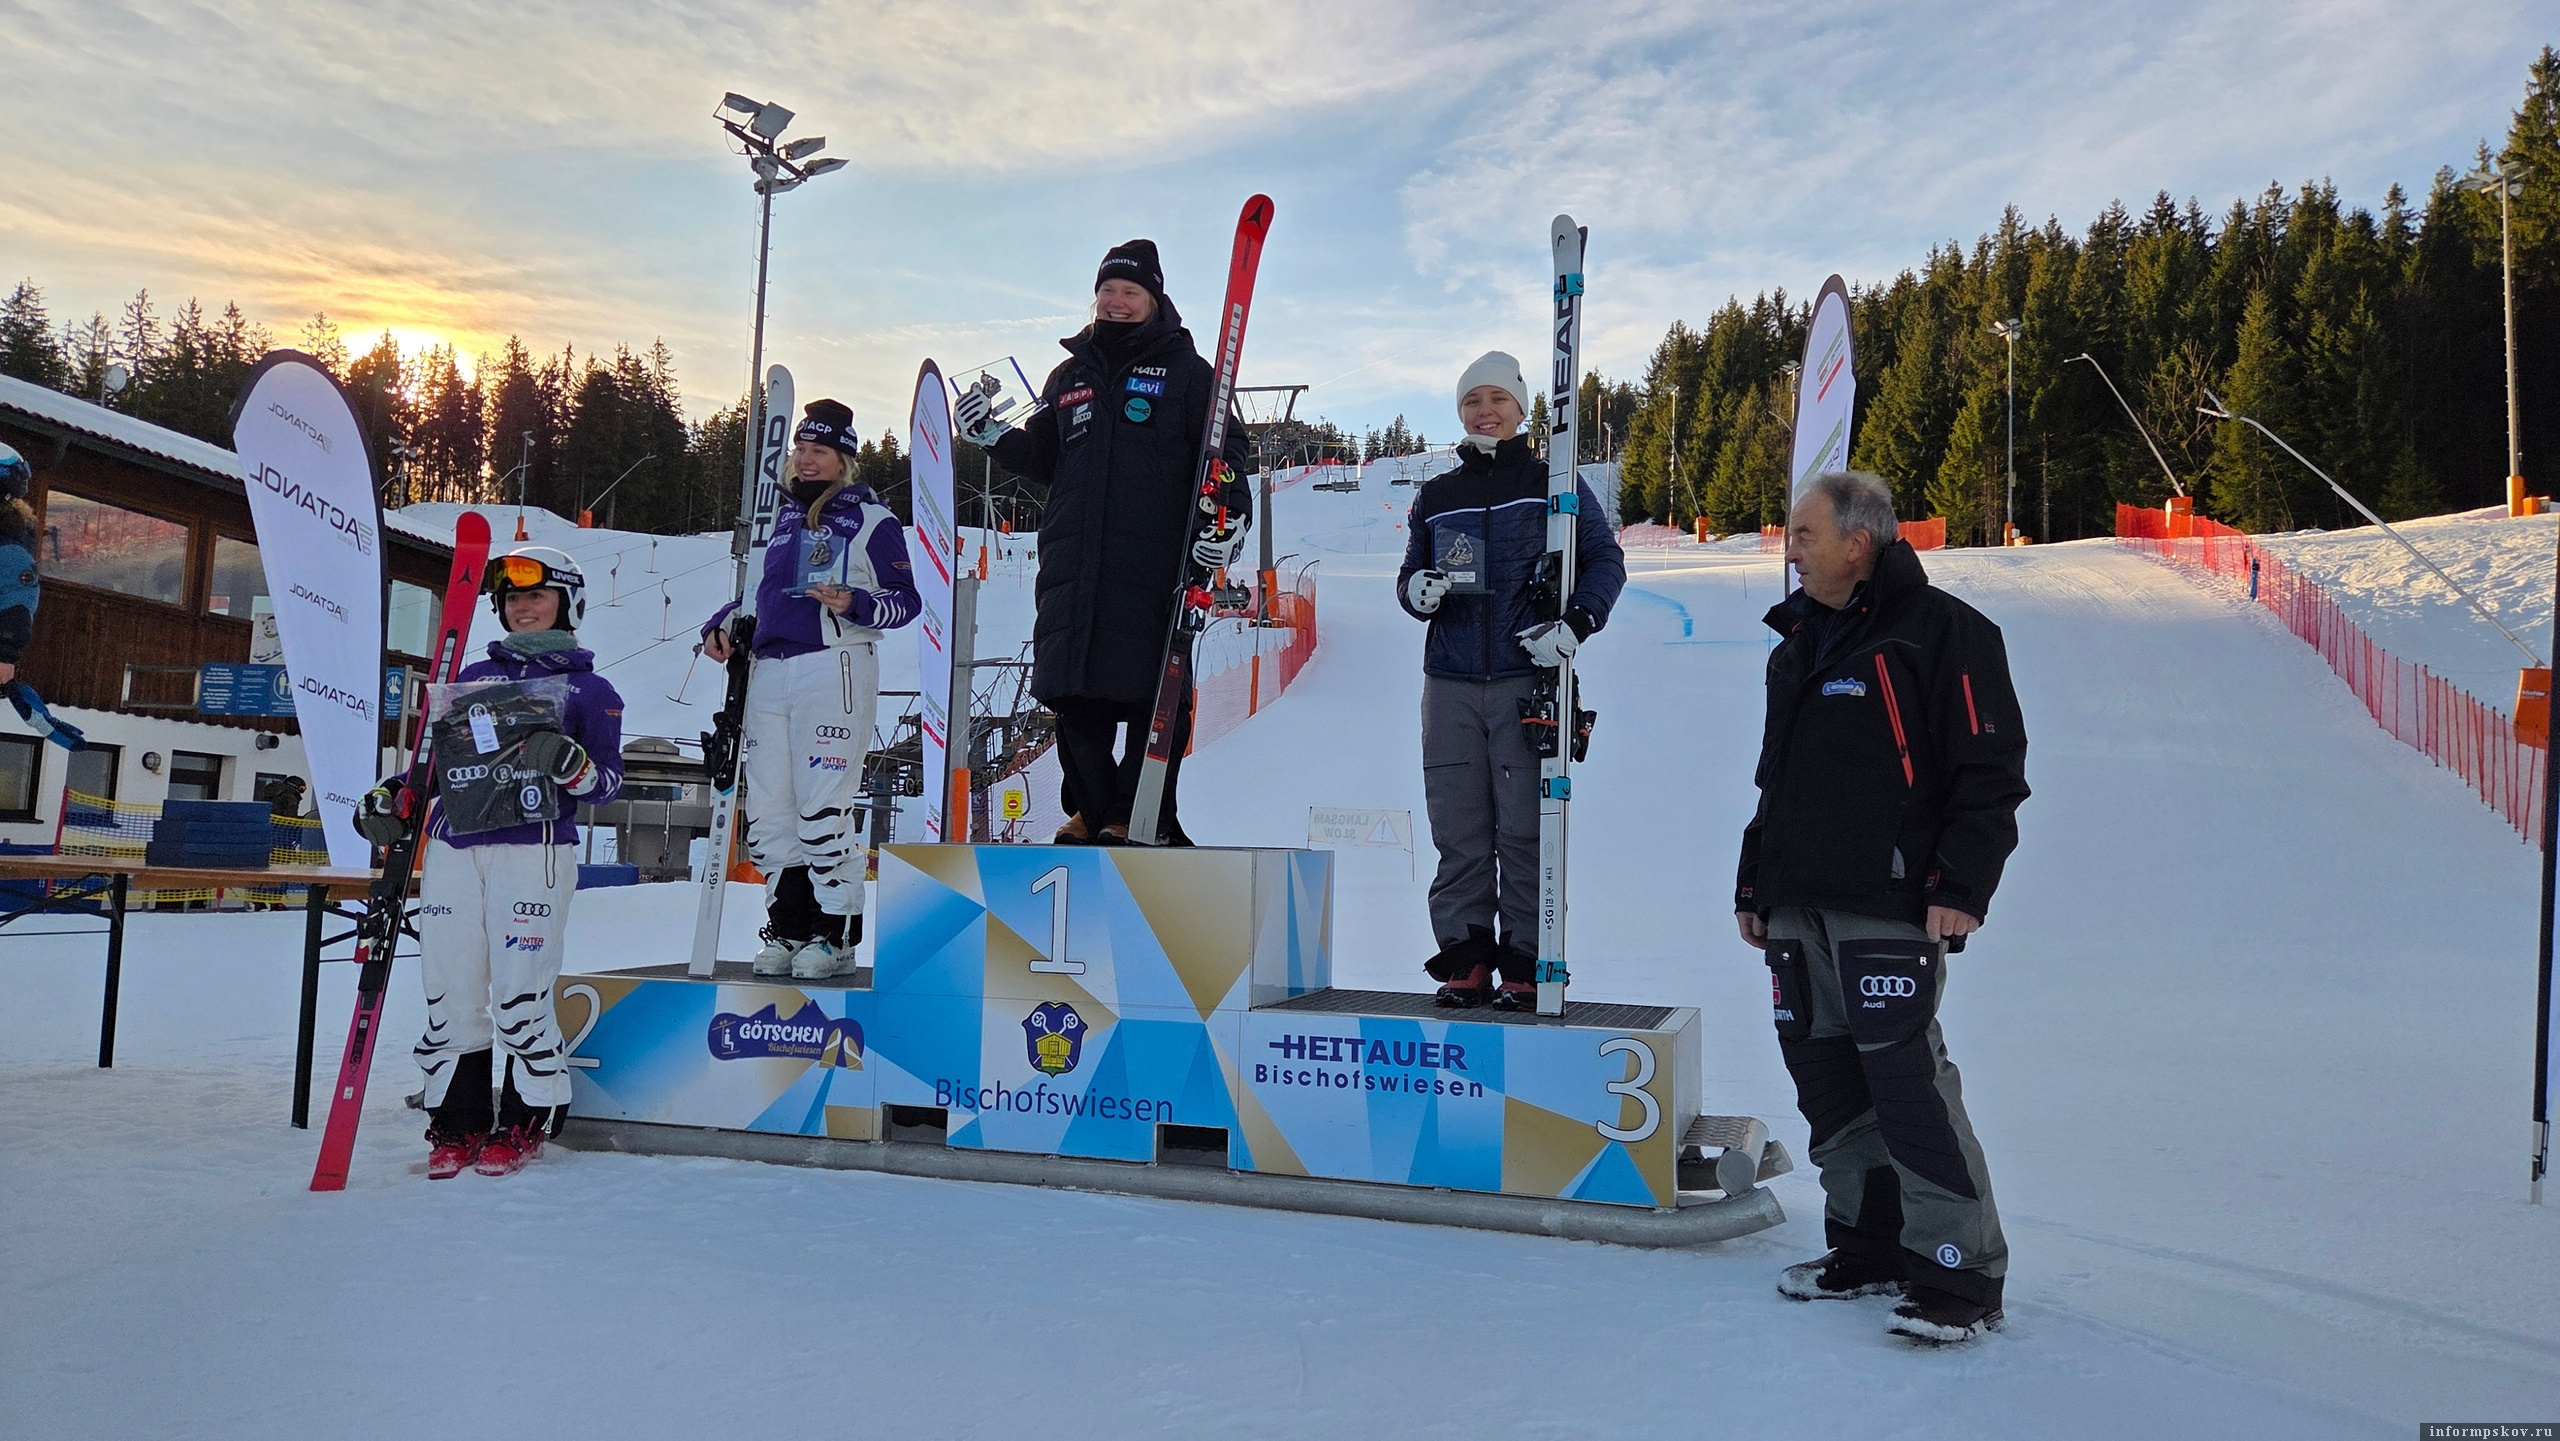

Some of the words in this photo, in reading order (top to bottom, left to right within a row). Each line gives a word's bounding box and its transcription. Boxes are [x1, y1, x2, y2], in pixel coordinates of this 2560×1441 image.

[1132, 365, 1167, 377] HALTI
[1130, 377, 1160, 394] Levi
[807, 421, 832, 434] ACP
[751, 414, 787, 549] HEAD
[834, 515, 860, 530] digits
[551, 570, 581, 584] uvex
[821, 764, 847, 772] SPORT
[822, 756, 847, 766] INTER
[423, 904, 452, 917] digits
[1029, 866, 1086, 975] 1
[519, 935, 545, 945] INTER
[518, 943, 544, 952] SPORT
[1919, 956, 1928, 966] B
[1862, 1000, 1886, 1008] Audi
[562, 983, 600, 1068] 2
[738, 1019, 825, 1045] GÖTSCHEN
[767, 1042, 822, 1056] Bischofswiesen
[1269, 1034, 1469, 1071] HEITAUER
[1255, 1063, 1484, 1099] Bischofswiesen
[1596, 1037, 1662, 1143] 3
[934, 1078, 1174, 1124] Bischofswiesen
